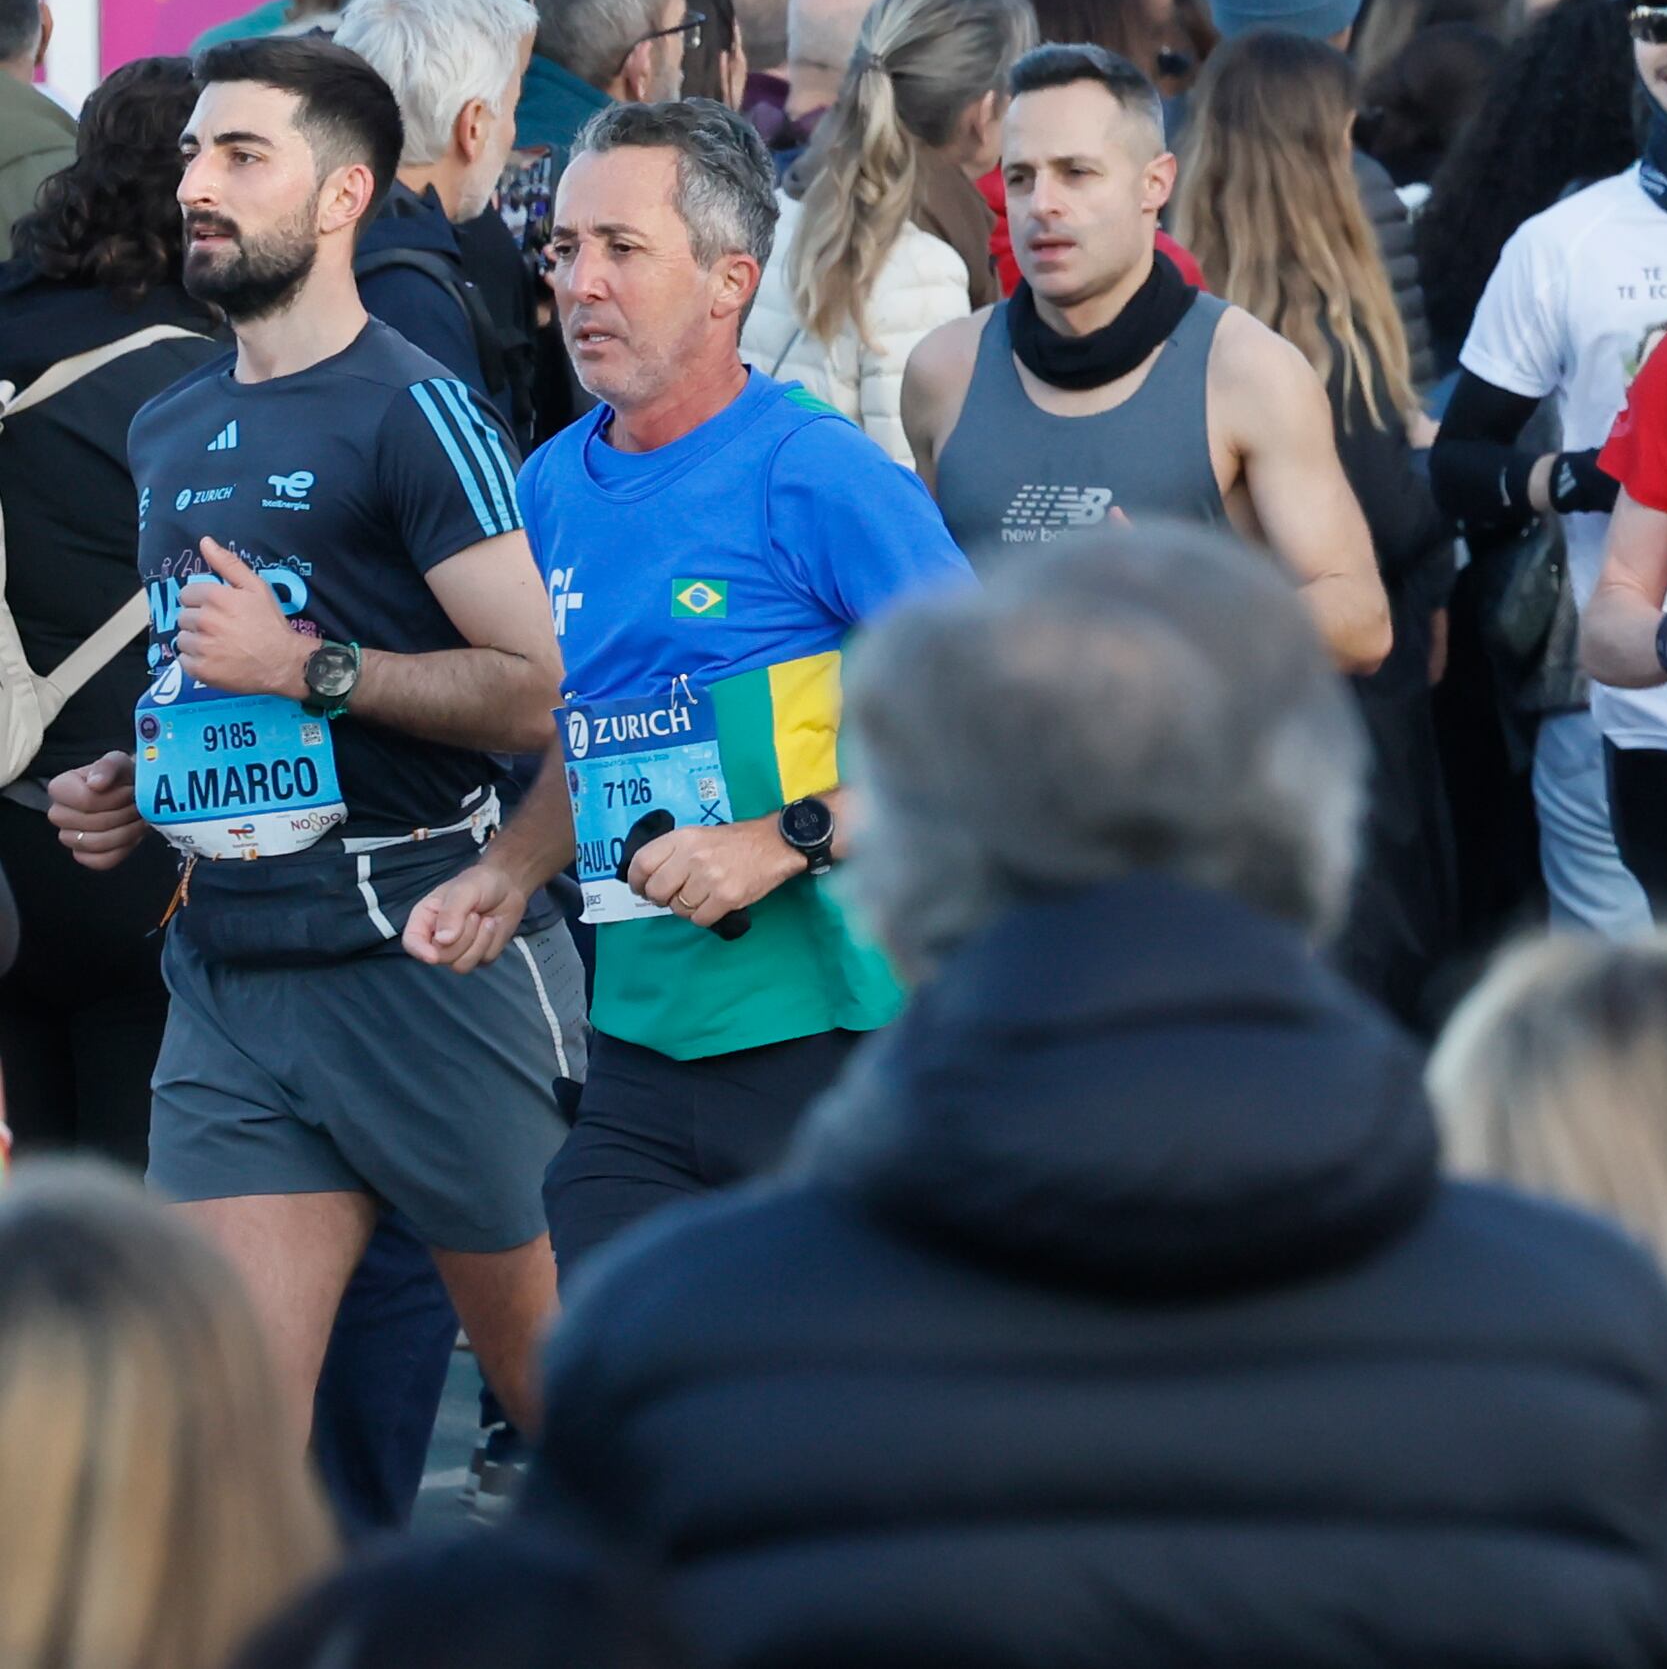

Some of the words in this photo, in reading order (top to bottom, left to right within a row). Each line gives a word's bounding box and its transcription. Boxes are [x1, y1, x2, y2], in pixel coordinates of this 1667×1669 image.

[1642, 267, 1661, 281] TE
[1617, 285, 1637, 300] TE
[193, 485, 233, 506] ZURICH
[203, 721, 257, 752] 9185
[594, 707, 693, 745] ZURICH
[153, 756, 319, 815] A.MARCO
[603, 777, 653, 809] 7126
[577, 835, 625, 875] PAULO
